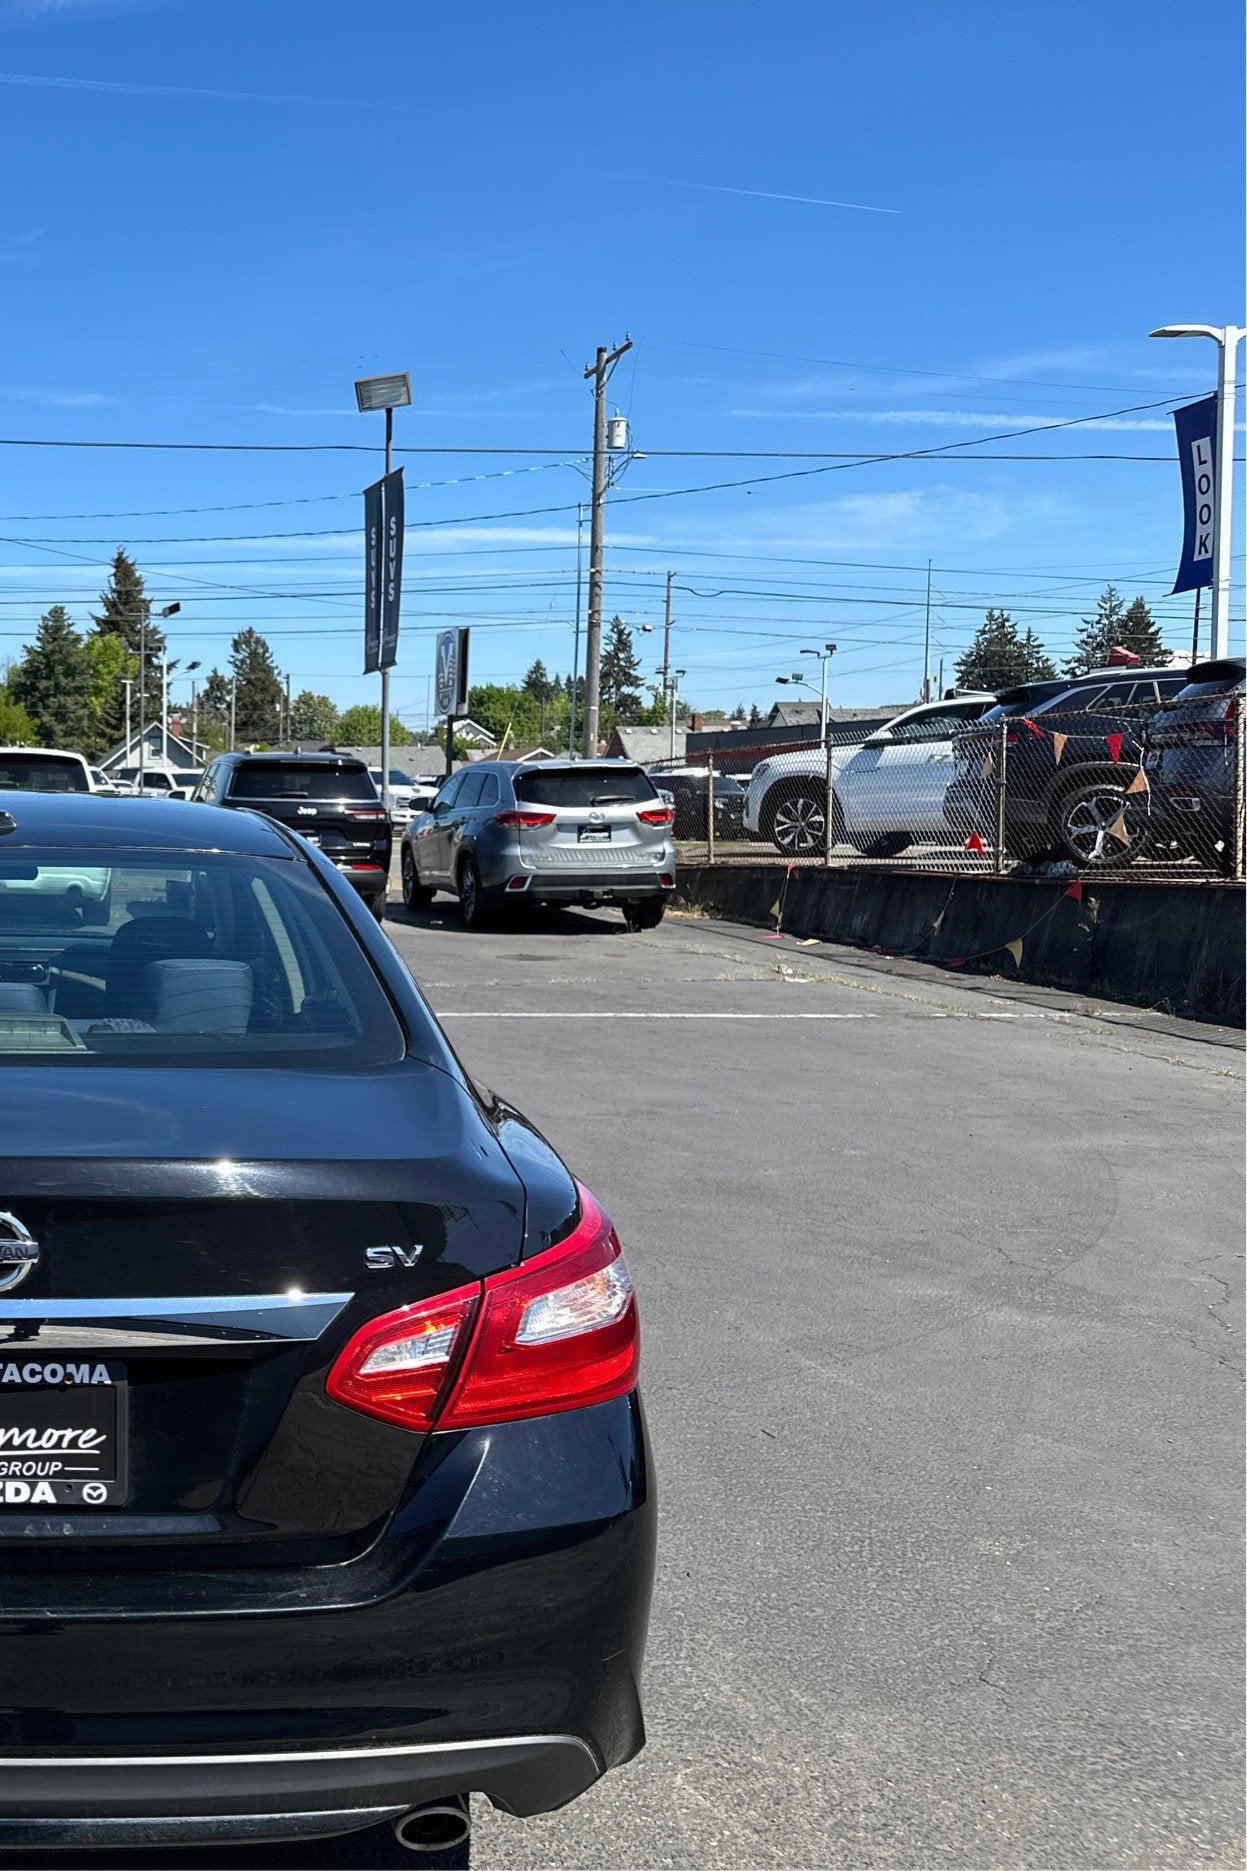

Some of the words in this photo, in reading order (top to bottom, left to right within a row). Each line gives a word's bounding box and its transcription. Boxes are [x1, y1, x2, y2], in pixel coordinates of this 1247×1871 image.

[1196, 444, 1212, 556] LOOK
[387, 515, 397, 602] SUVS
[365, 1244, 424, 1270] SV
